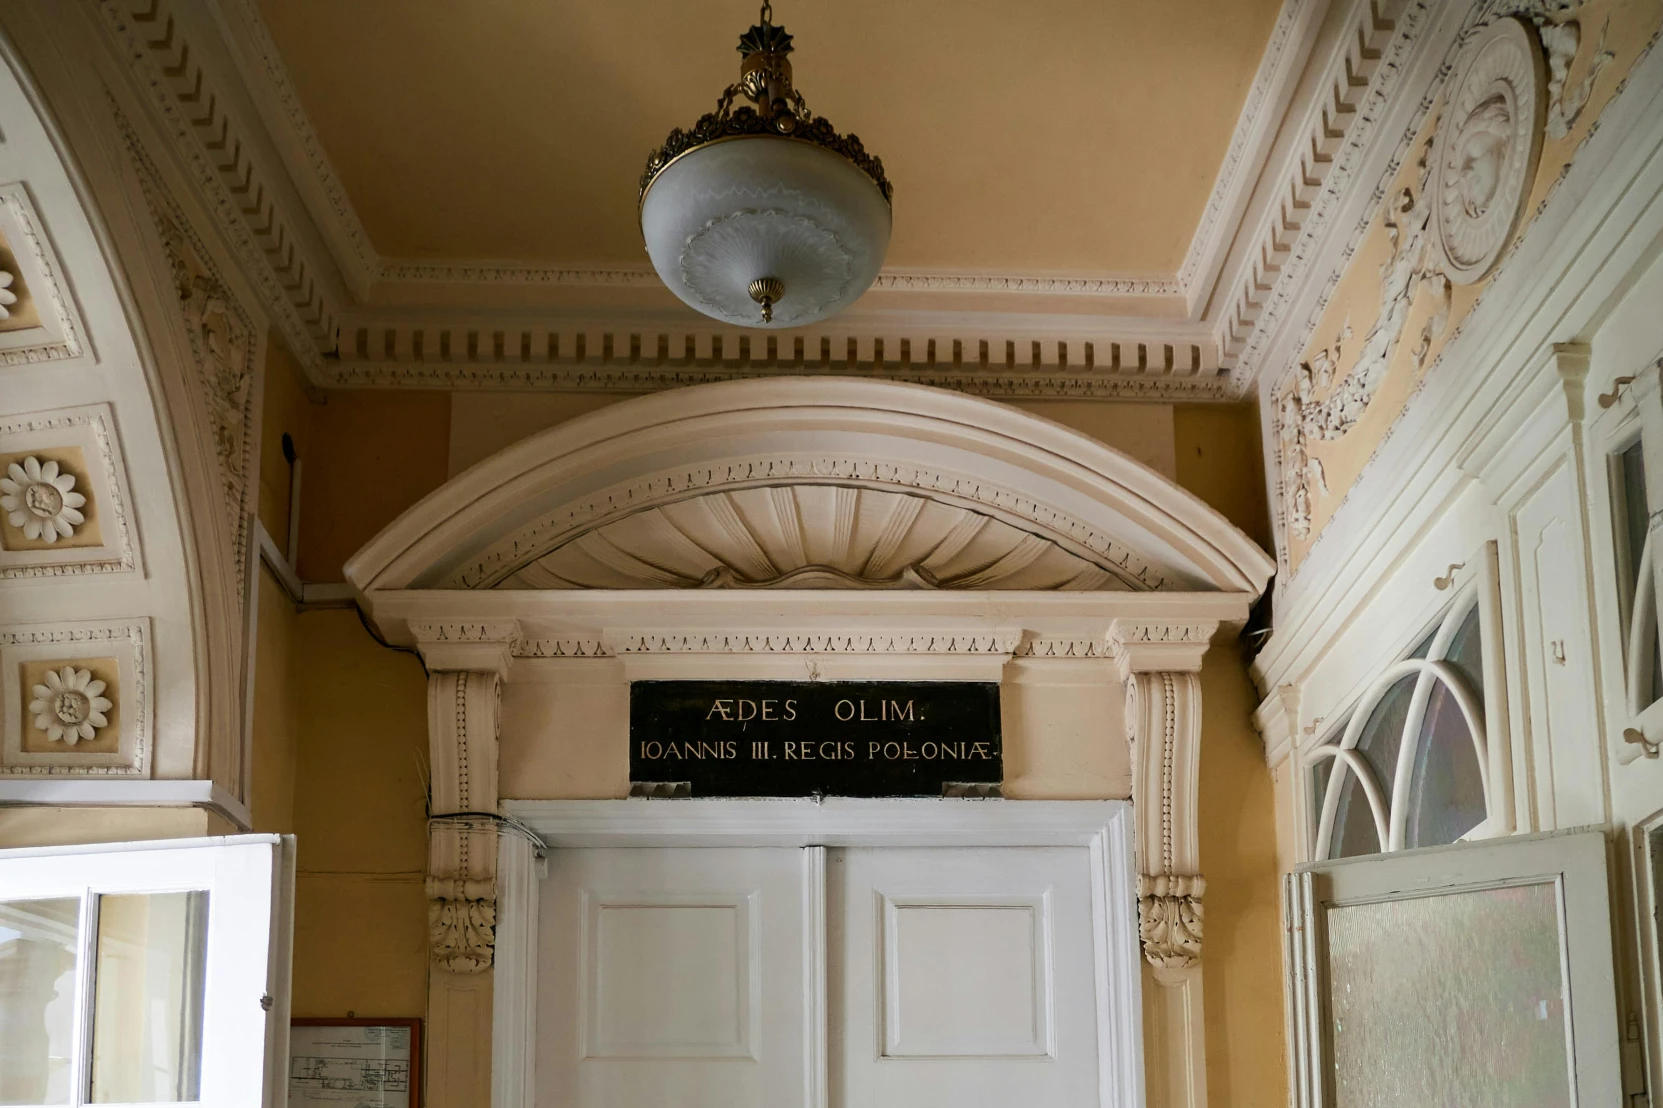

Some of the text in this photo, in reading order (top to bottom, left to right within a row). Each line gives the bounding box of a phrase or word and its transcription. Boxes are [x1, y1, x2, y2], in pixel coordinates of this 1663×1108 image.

[705, 699, 926, 722] ÆDES OLIM.
[640, 741, 737, 760] IOANNIS
[751, 741, 777, 760] III.
[784, 741, 855, 760] REGIS
